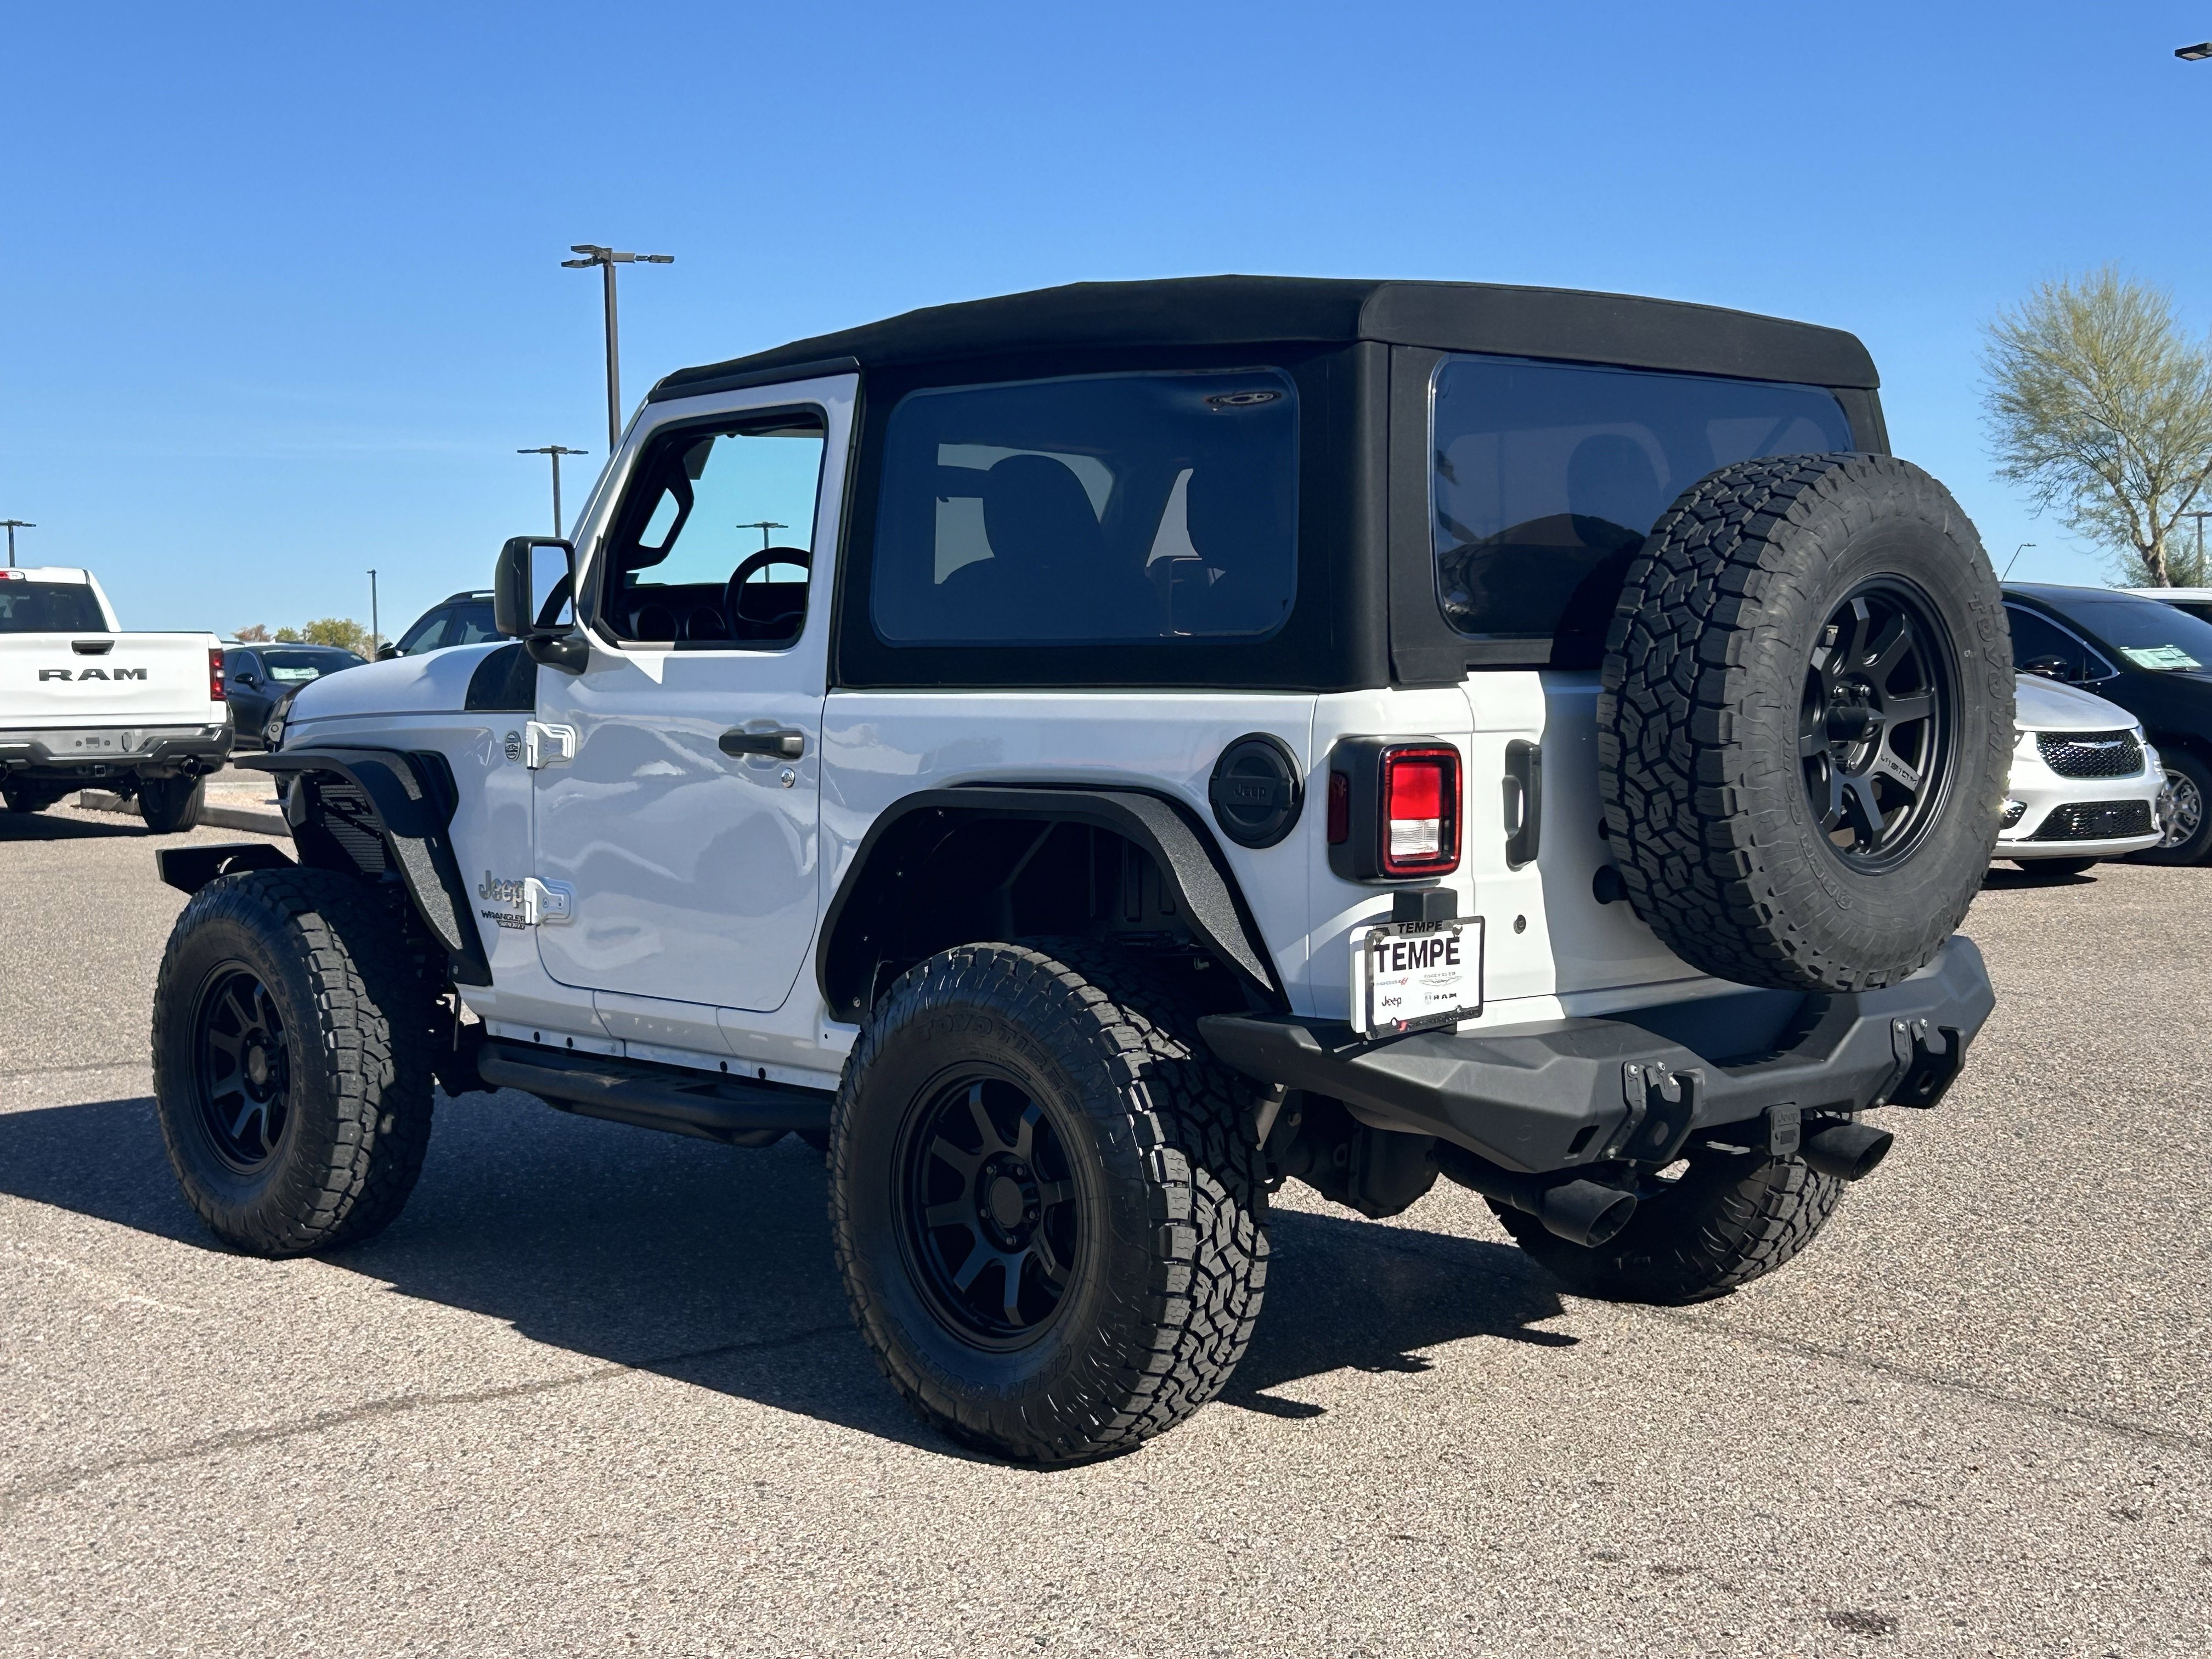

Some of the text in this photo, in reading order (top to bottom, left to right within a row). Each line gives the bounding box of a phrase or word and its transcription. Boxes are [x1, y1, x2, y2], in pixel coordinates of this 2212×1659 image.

[1968, 590, 2001, 698] TOYO
[38, 668, 147, 681] RAM
[1233, 783, 1265, 800] Jeep
[478, 870, 524, 909] Jeep
[481, 910, 526, 922] WRANGLER
[1398, 921, 1443, 933] TEMPE
[1374, 937, 1460, 973] TEMPE
[1381, 996, 1402, 1007] Jeep
